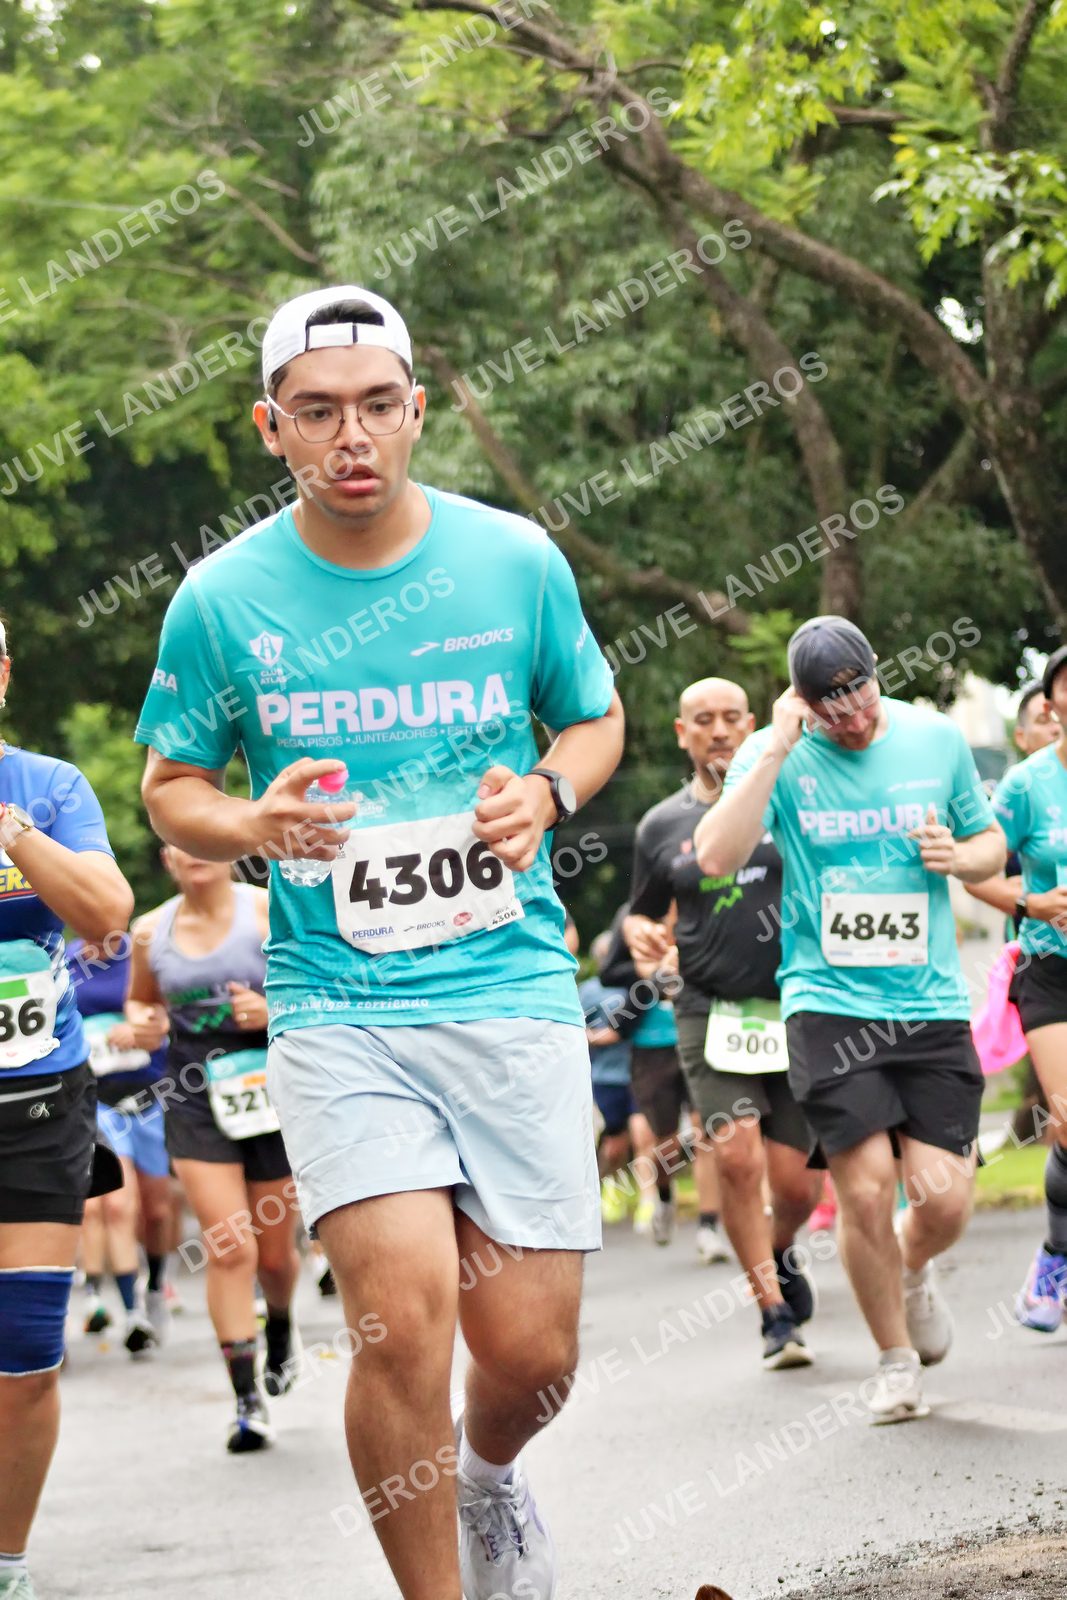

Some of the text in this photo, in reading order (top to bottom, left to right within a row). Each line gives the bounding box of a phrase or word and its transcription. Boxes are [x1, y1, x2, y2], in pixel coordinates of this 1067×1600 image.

[443, 627, 514, 651] BROOKS
[256, 673, 510, 737] PERDURA
[277, 736, 305, 748] PEGA
[307, 735, 343, 747] PISOS
[352, 726, 438, 745] JUNTEADORES
[349, 840, 504, 909] 4306
[352, 920, 446, 939] PERDURA BROOKS
[830, 912, 920, 940] 4843
[726, 1033, 778, 1056] 900
